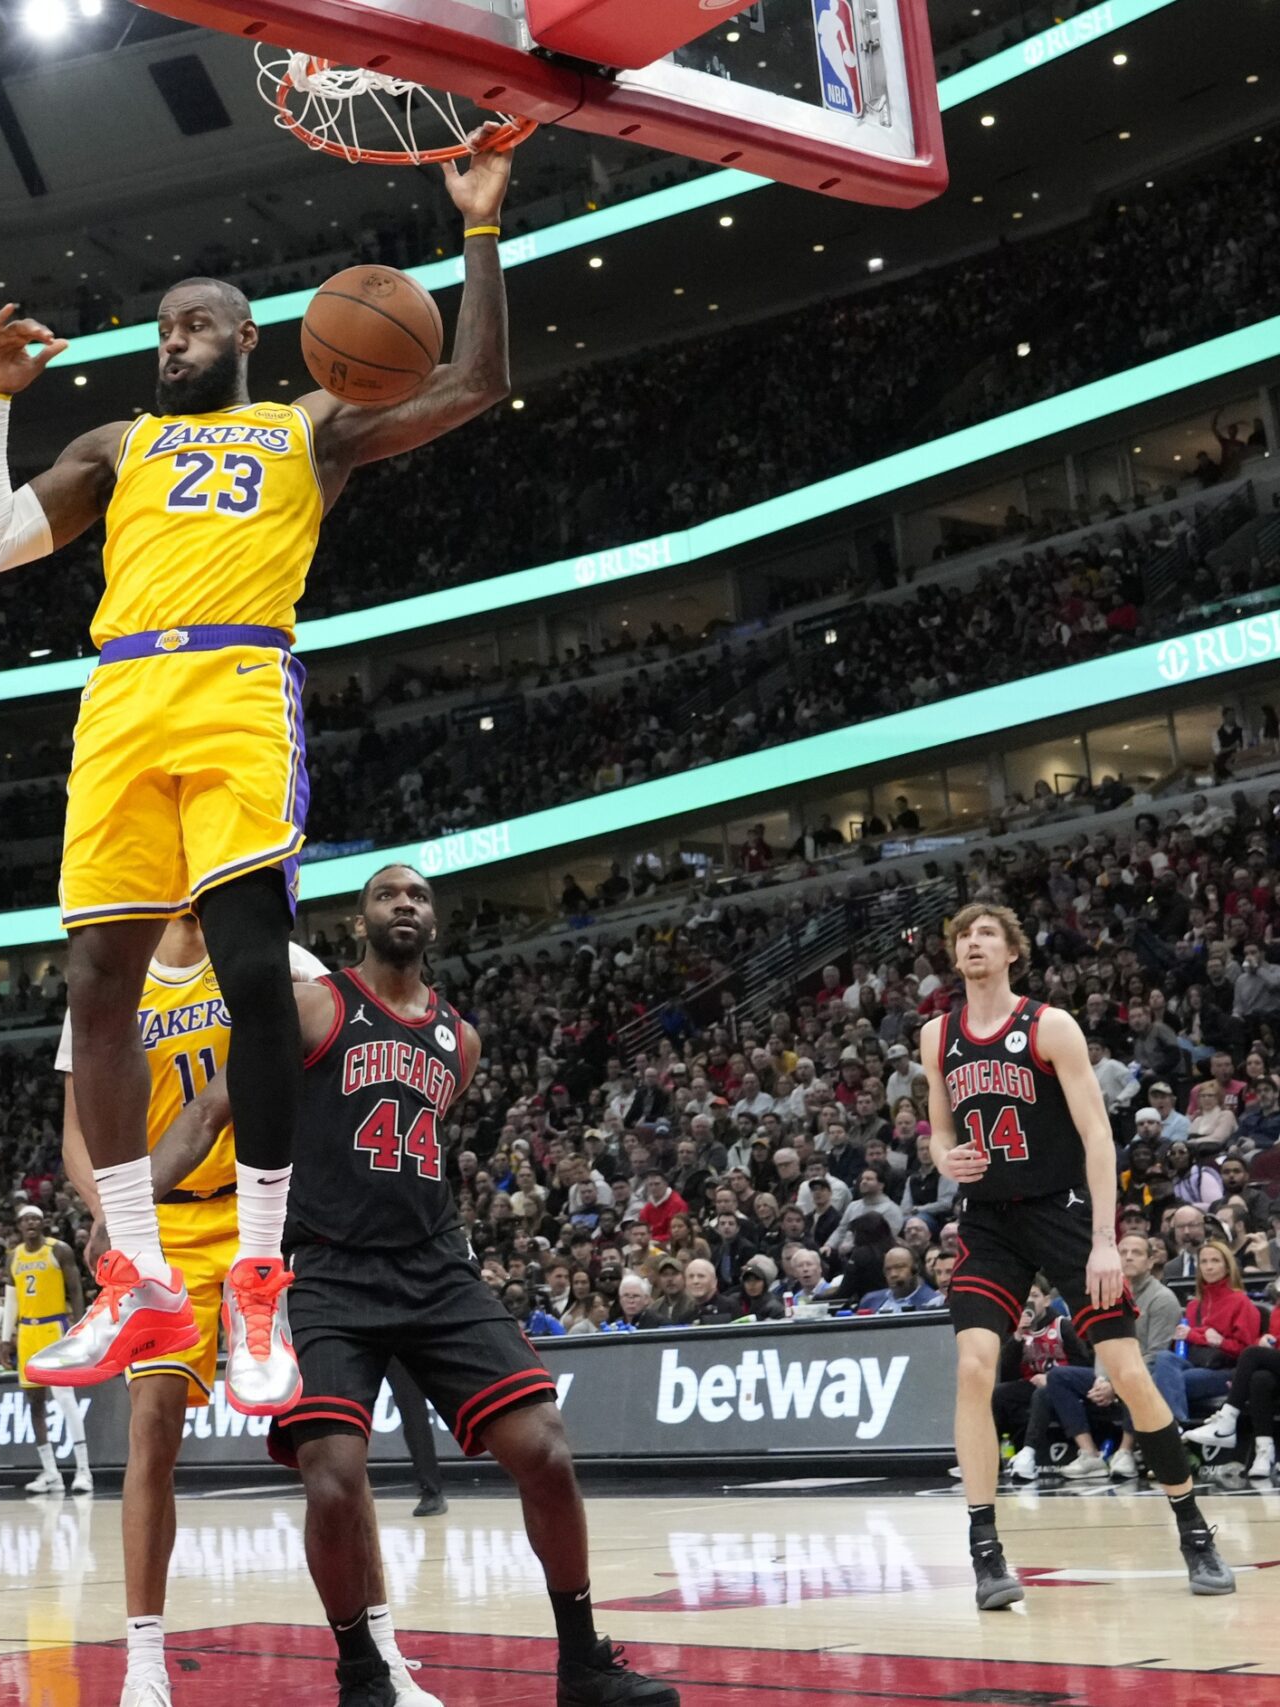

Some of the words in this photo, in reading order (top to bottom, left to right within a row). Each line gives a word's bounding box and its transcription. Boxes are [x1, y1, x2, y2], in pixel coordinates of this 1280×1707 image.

[1045, 4, 1115, 54] RUSH
[827, 83, 849, 107] NBA
[143, 421, 291, 459] LAKERS
[166, 451, 265, 519] 23
[598, 537, 673, 579] RUSH
[444, 823, 512, 869] RUSH
[174, 1044, 218, 1109] 11
[341, 1039, 456, 1121] CHICAGO
[945, 1059, 1037, 1112] CHICAGO
[353, 1097, 442, 1182] 44
[964, 1105, 1029, 1164] 14
[25, 1274, 37, 1297] 2
[657, 1349, 910, 1440] betway
